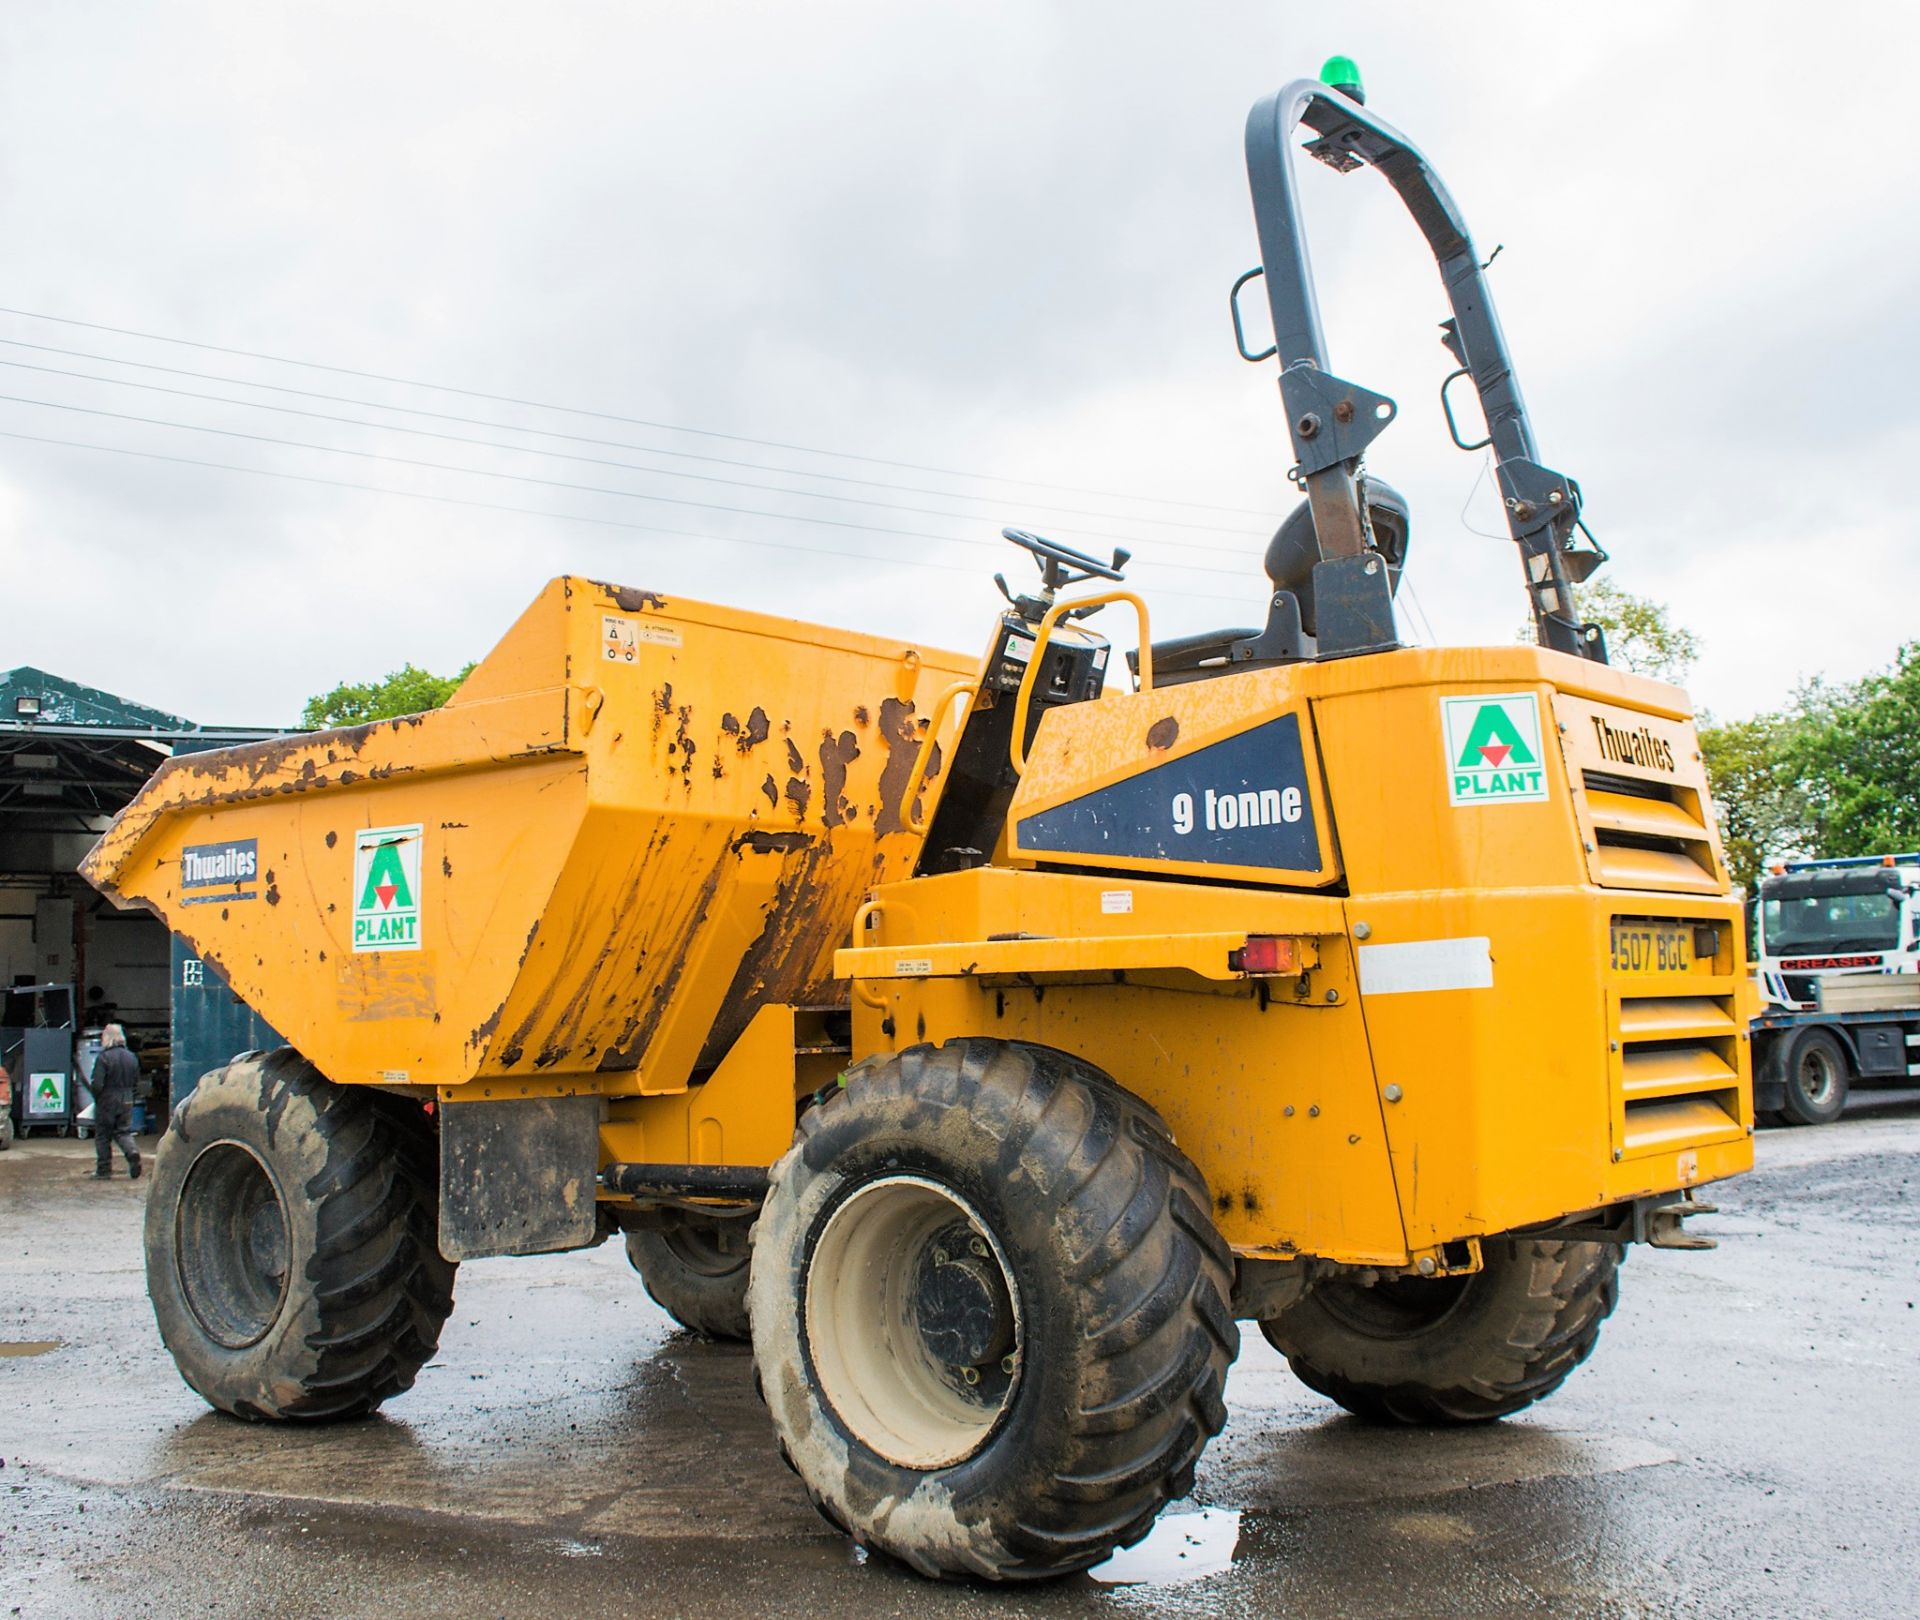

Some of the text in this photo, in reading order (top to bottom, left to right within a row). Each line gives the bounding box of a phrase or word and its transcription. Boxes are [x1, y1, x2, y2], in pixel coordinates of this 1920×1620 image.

[1591, 715, 1675, 773] Thwaites
[1455, 772, 1543, 796] PLANT
[1172, 786, 1302, 835] 9 tonne
[184, 847, 256, 882] Thwaites
[355, 916, 417, 942] PLANT
[1782, 955, 1880, 970] CREASEY
[32, 1101, 62, 1109] PANT
